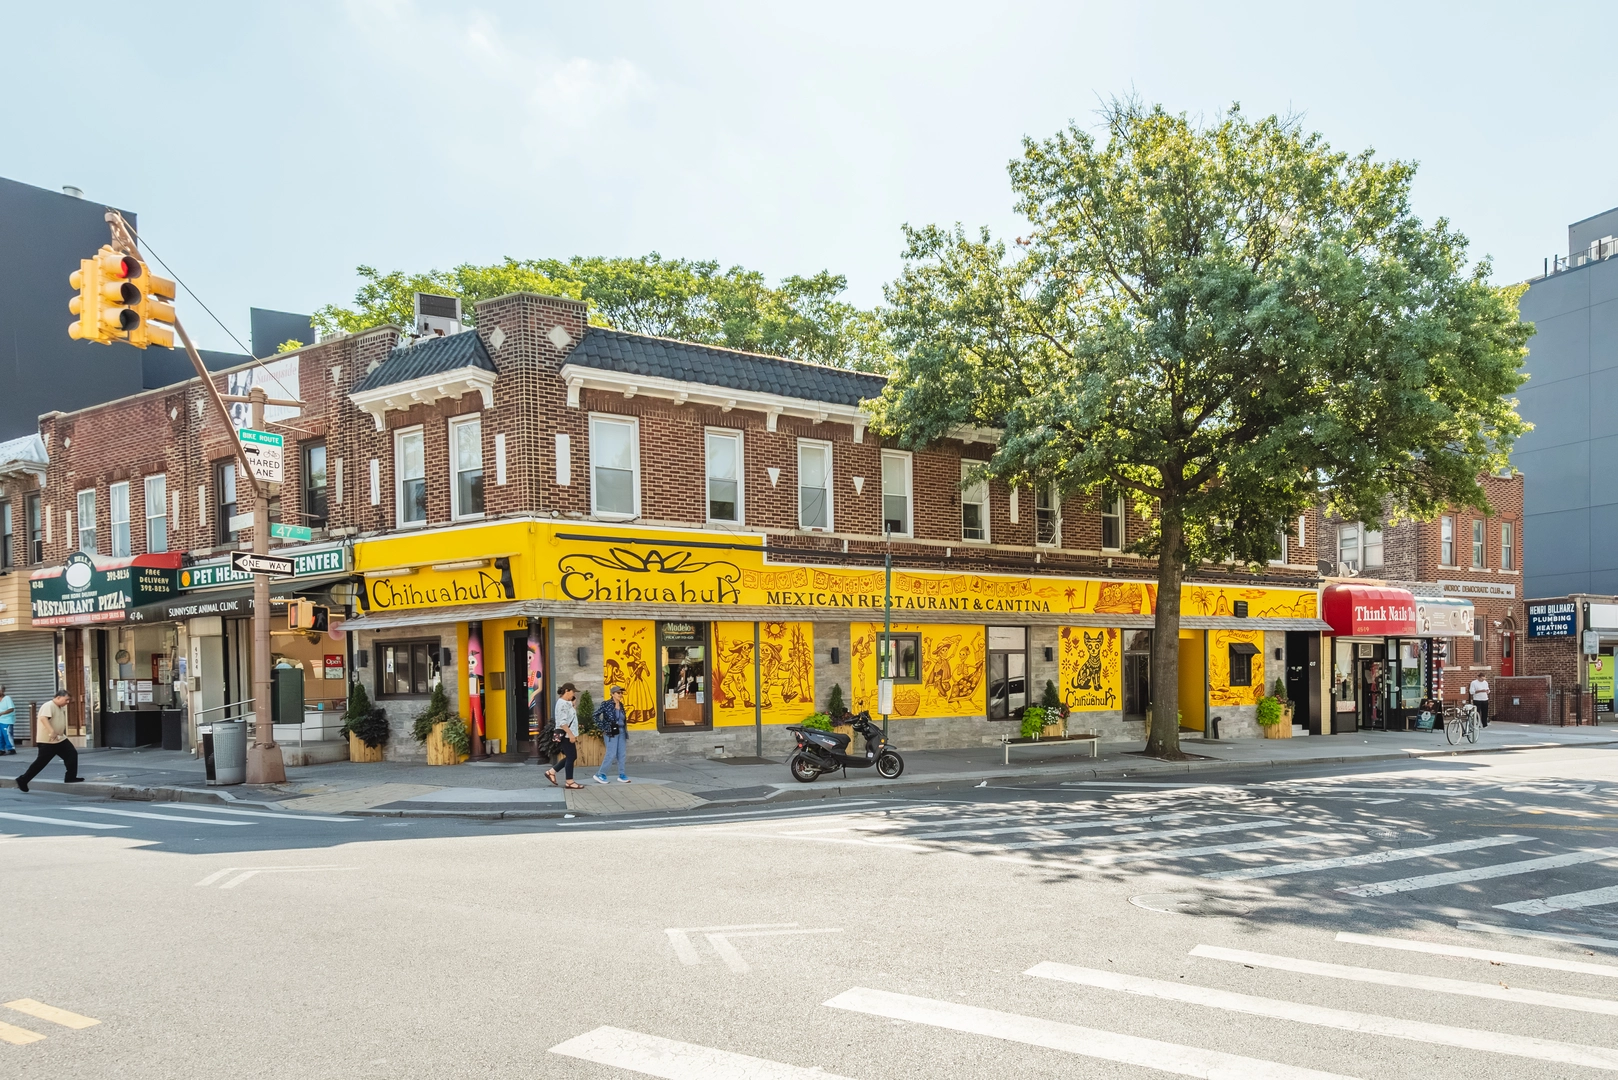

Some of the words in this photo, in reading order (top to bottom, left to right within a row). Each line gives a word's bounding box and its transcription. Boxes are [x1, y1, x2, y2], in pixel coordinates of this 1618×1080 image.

[256, 362, 297, 385] Sunnyside
[242, 431, 257, 441] BIKE
[259, 434, 280, 445] ROUTE
[247, 457, 281, 469] HARED
[254, 468, 274, 478] ANE
[276, 526, 293, 538] 47
[193, 569, 212, 585] PET
[294, 552, 340, 573] CENTER
[242, 559, 261, 568] ONE
[268, 561, 288, 570] WAY
[106, 569, 130, 582] 392-8236
[144, 568, 161, 576] FREE
[139, 576, 170, 584] DELIVERY
[140, 584, 170, 593] 392-8236
[1462, 586, 1489, 594] DEMOCRATIC
[37, 598, 95, 617] RESTAURANT
[98, 590, 125, 611] PIZZA
[766, 591, 854, 607] MEXICAN
[858, 594, 969, 610] RESTAURANT
[973, 598, 984, 610] &
[986, 599, 1051, 612] CANTINA
[168, 605, 199, 617] SUNNYSIDE
[198, 603, 219, 614] ANIMAL
[219, 600, 239, 611] CLINIC
[1354, 606, 1387, 621] Think
[1388, 606, 1408, 621] Nails
[1529, 605, 1547, 615] HENRI
[1547, 603, 1575, 614] BILLHARZ
[1532, 615, 1572, 623] PLUMBING
[667, 622, 692, 633] Modelo
[1536, 624, 1568, 632] HEATING
